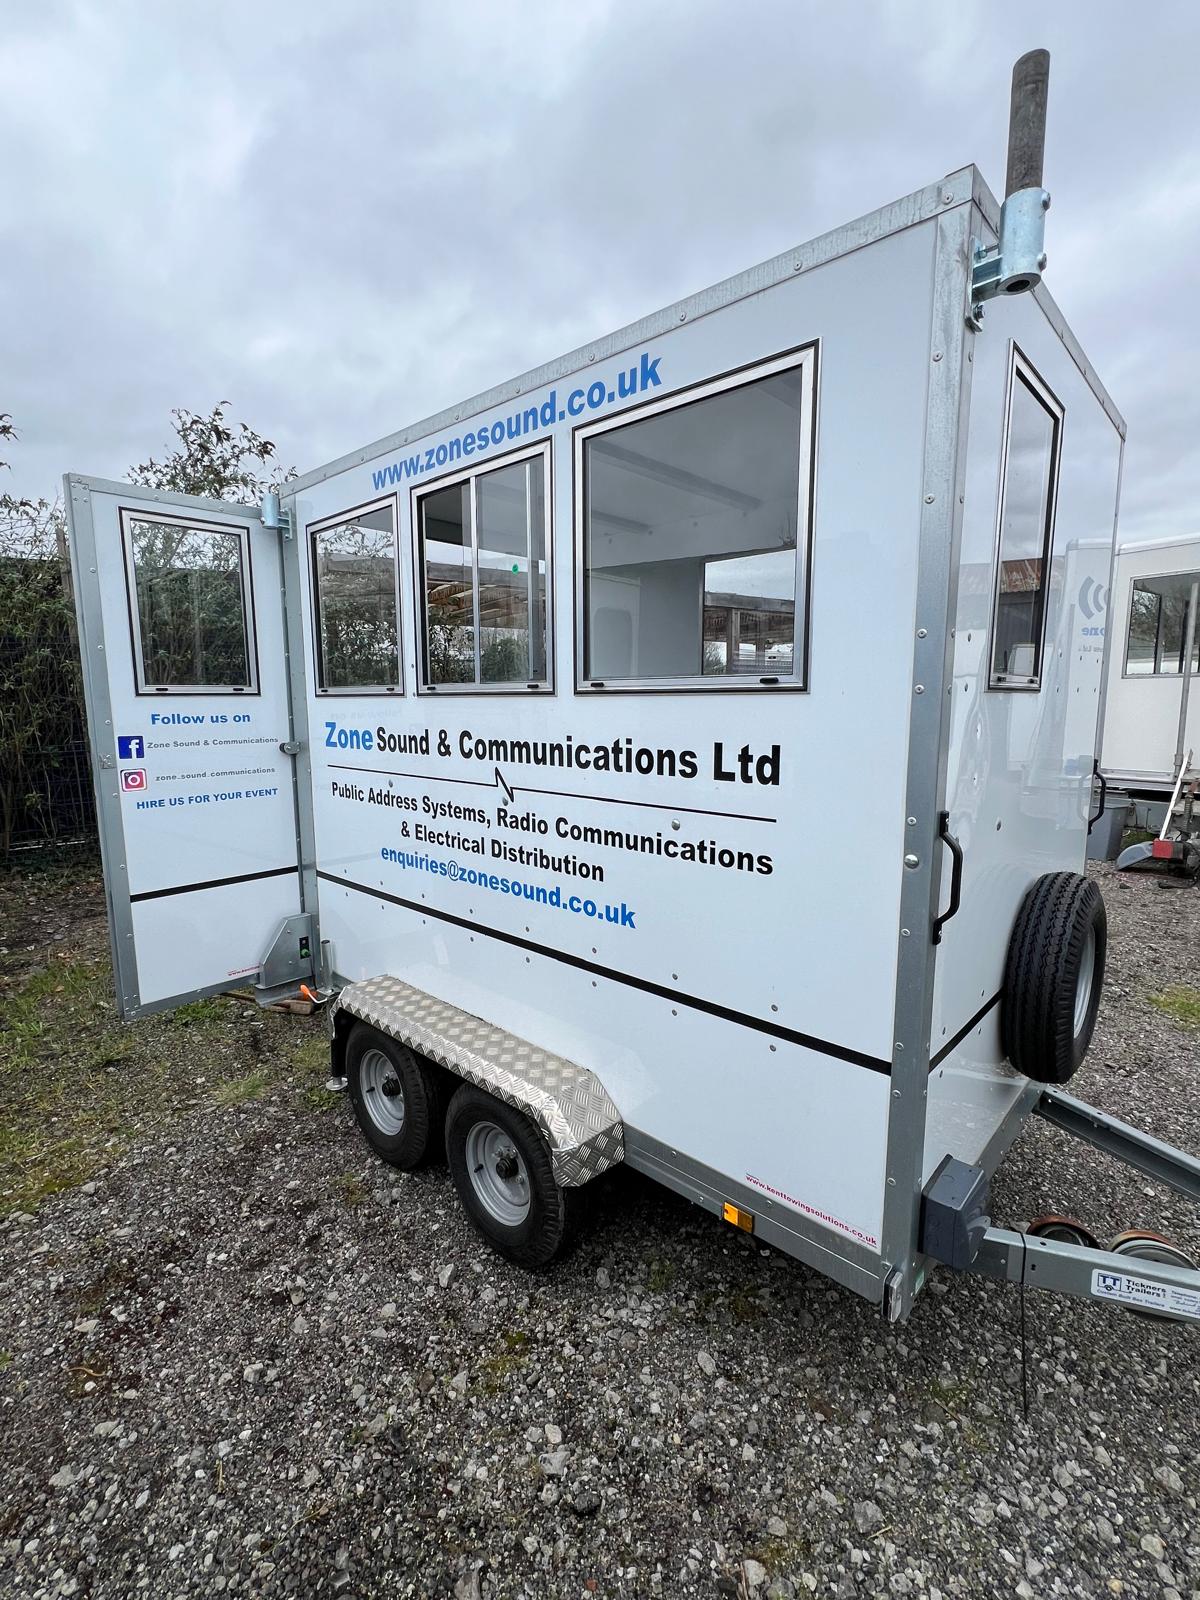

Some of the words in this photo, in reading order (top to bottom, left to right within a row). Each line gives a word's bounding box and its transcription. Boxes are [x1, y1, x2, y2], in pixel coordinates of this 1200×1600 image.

[372, 352, 663, 490] www.zonesound.co.uk
[151, 713, 204, 725] Follow
[210, 714, 227, 723] us
[233, 713, 251, 722] on
[212, 737, 279, 746] Communications
[324, 721, 374, 751] Zone
[376, 727, 430, 756] Sound
[436, 729, 451, 757] &
[458, 731, 699, 779] Communications
[713, 742, 782, 786] Ltd
[136, 800, 165, 810] HIRE
[169, 797, 185, 806] US
[188, 795, 210, 805] FOR
[214, 791, 242, 802] YOUR
[245, 788, 279, 798] EVENT
[331, 781, 365, 803] Public
[368, 787, 418, 812] Address
[422, 795, 492, 829] Systems,
[497, 807, 549, 835] Radio
[555, 817, 774, 876] Communications
[400, 820, 411, 838] &
[415, 826, 486, 855] Electrical
[490, 839, 604, 882] Distribution
[380, 847, 636, 929] enquiries@zonesound.co.uk
[745, 1175, 878, 1246] www.kenttowingsolutions.co.uk
[1126, 1279, 1167, 1292] Tickners
[1126, 1285, 1161, 1298] Trailers
